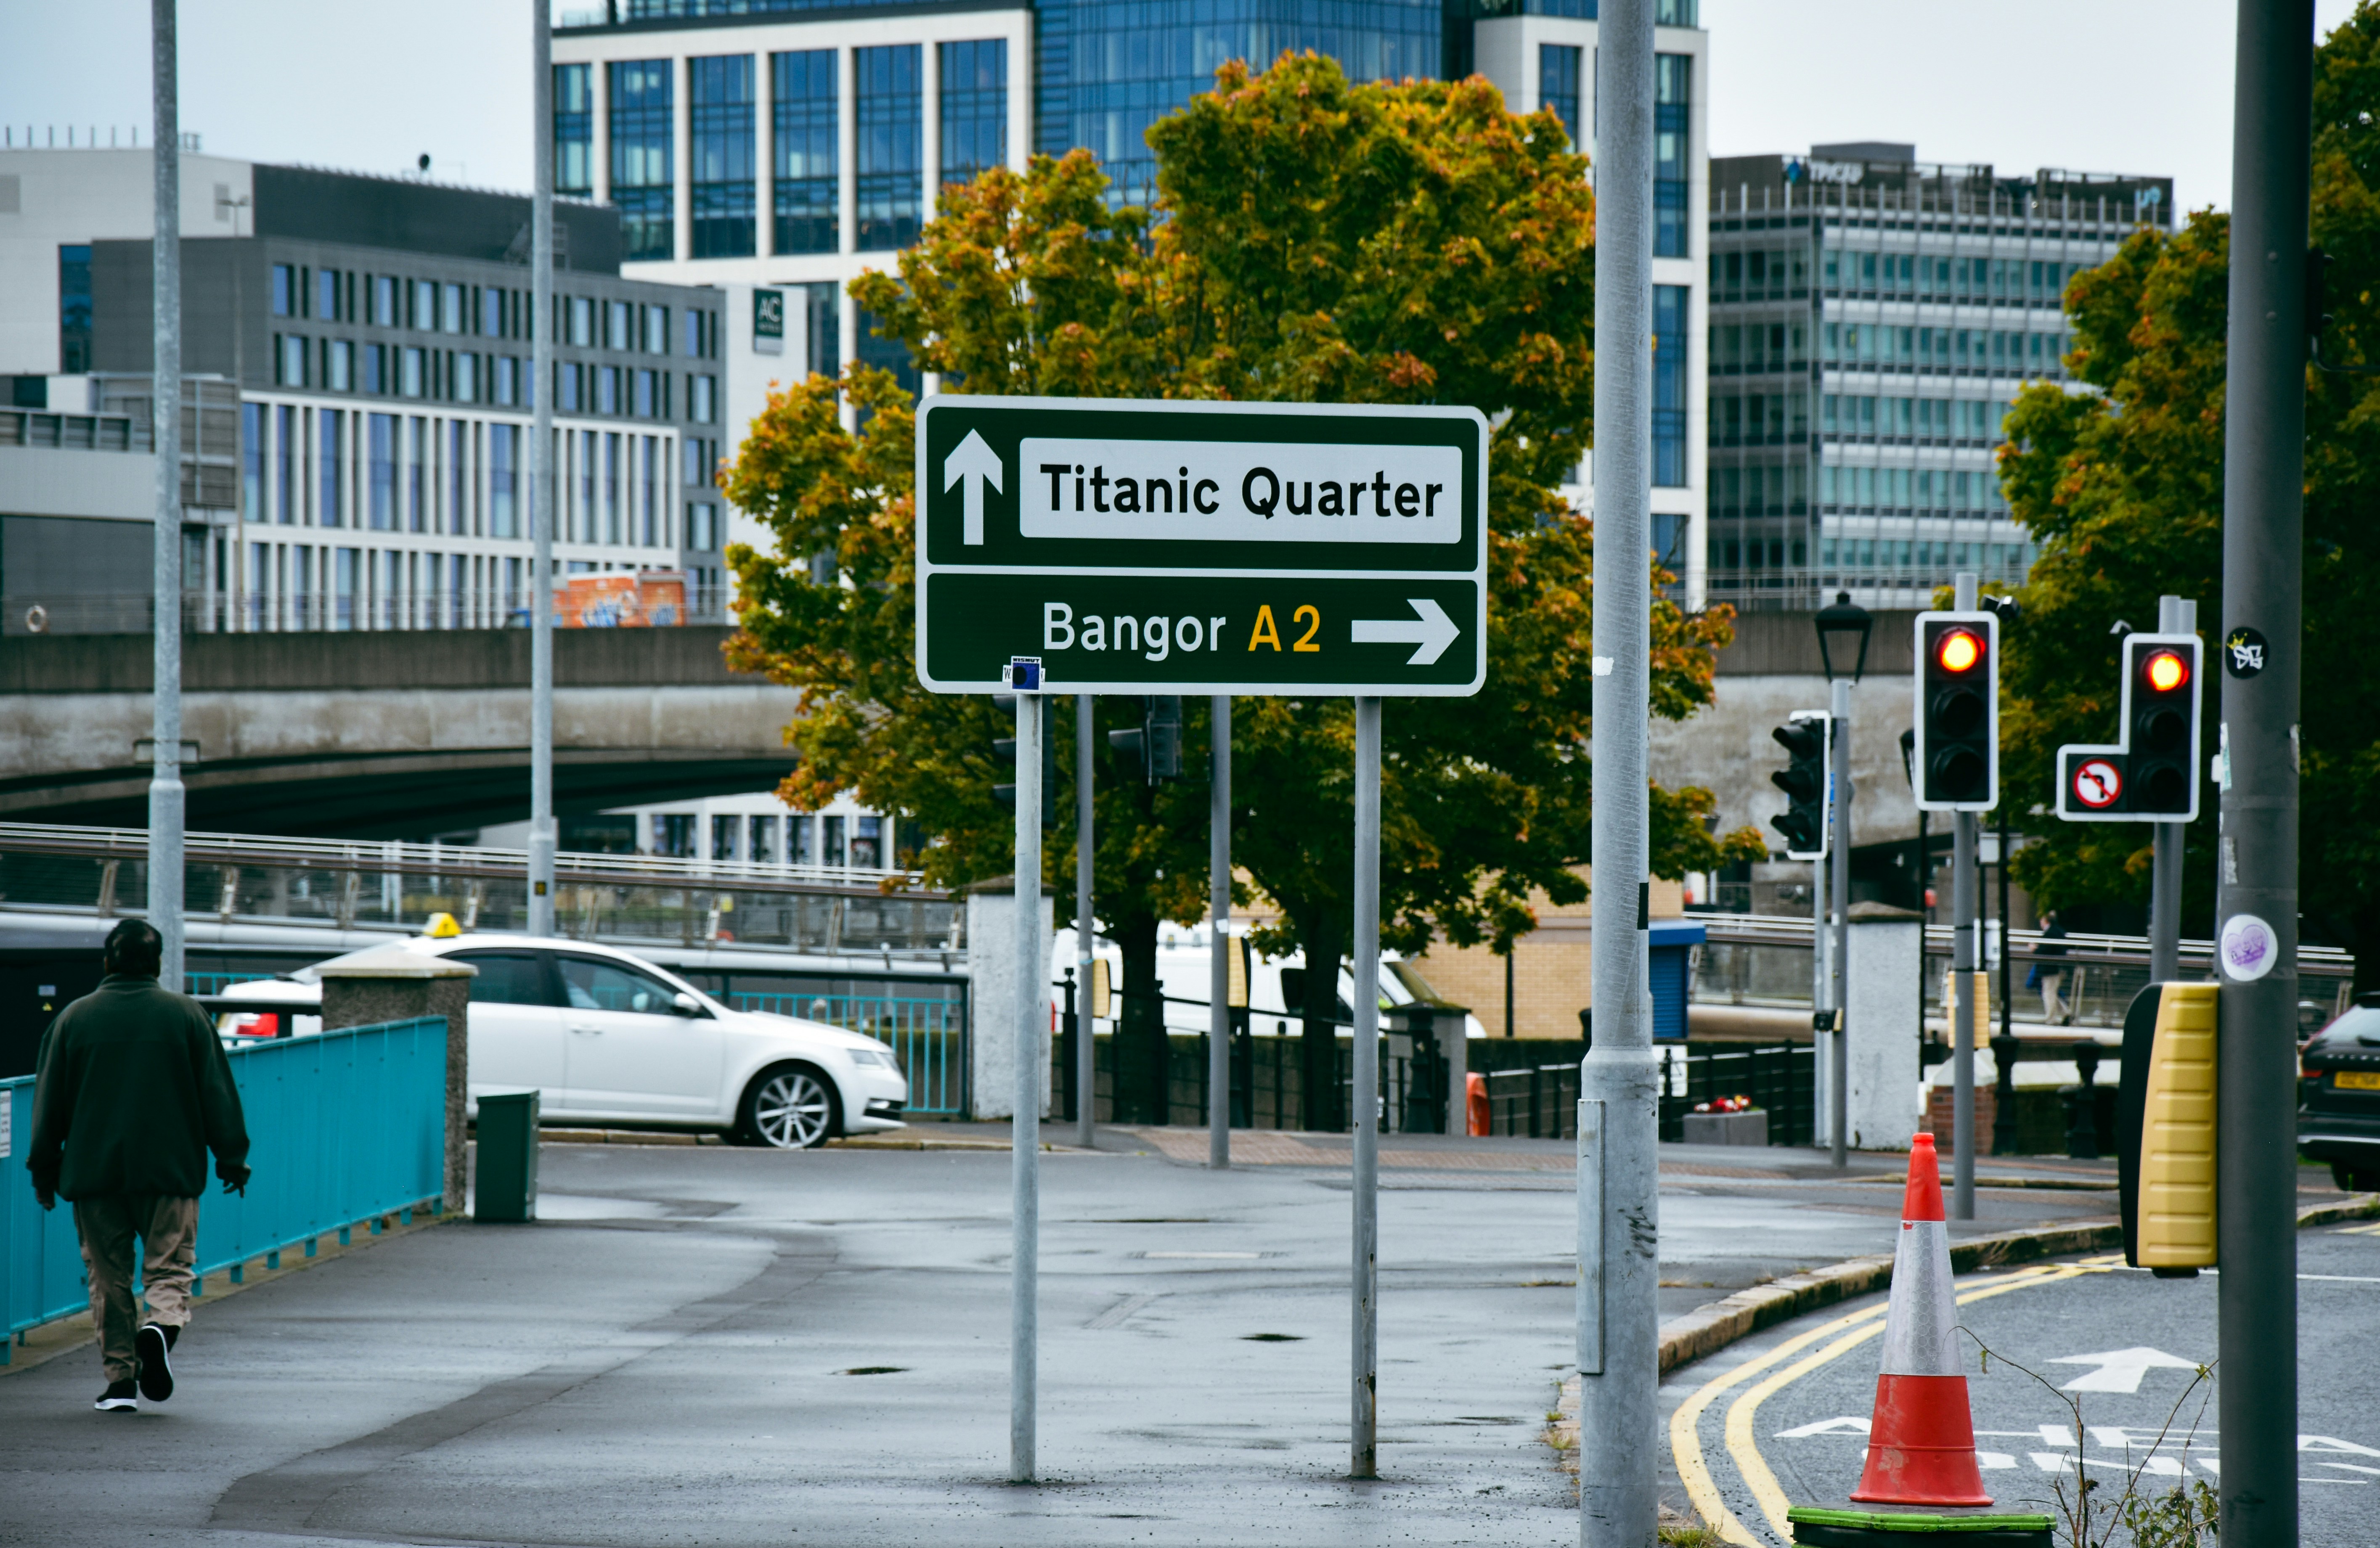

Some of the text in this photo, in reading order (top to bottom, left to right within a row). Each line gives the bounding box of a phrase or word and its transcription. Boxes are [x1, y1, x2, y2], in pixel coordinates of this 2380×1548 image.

[758, 296, 782, 323] AC
[1040, 463, 1443, 520] Titanic Quarter
[1044, 602, 1320, 662] Bangor A2
